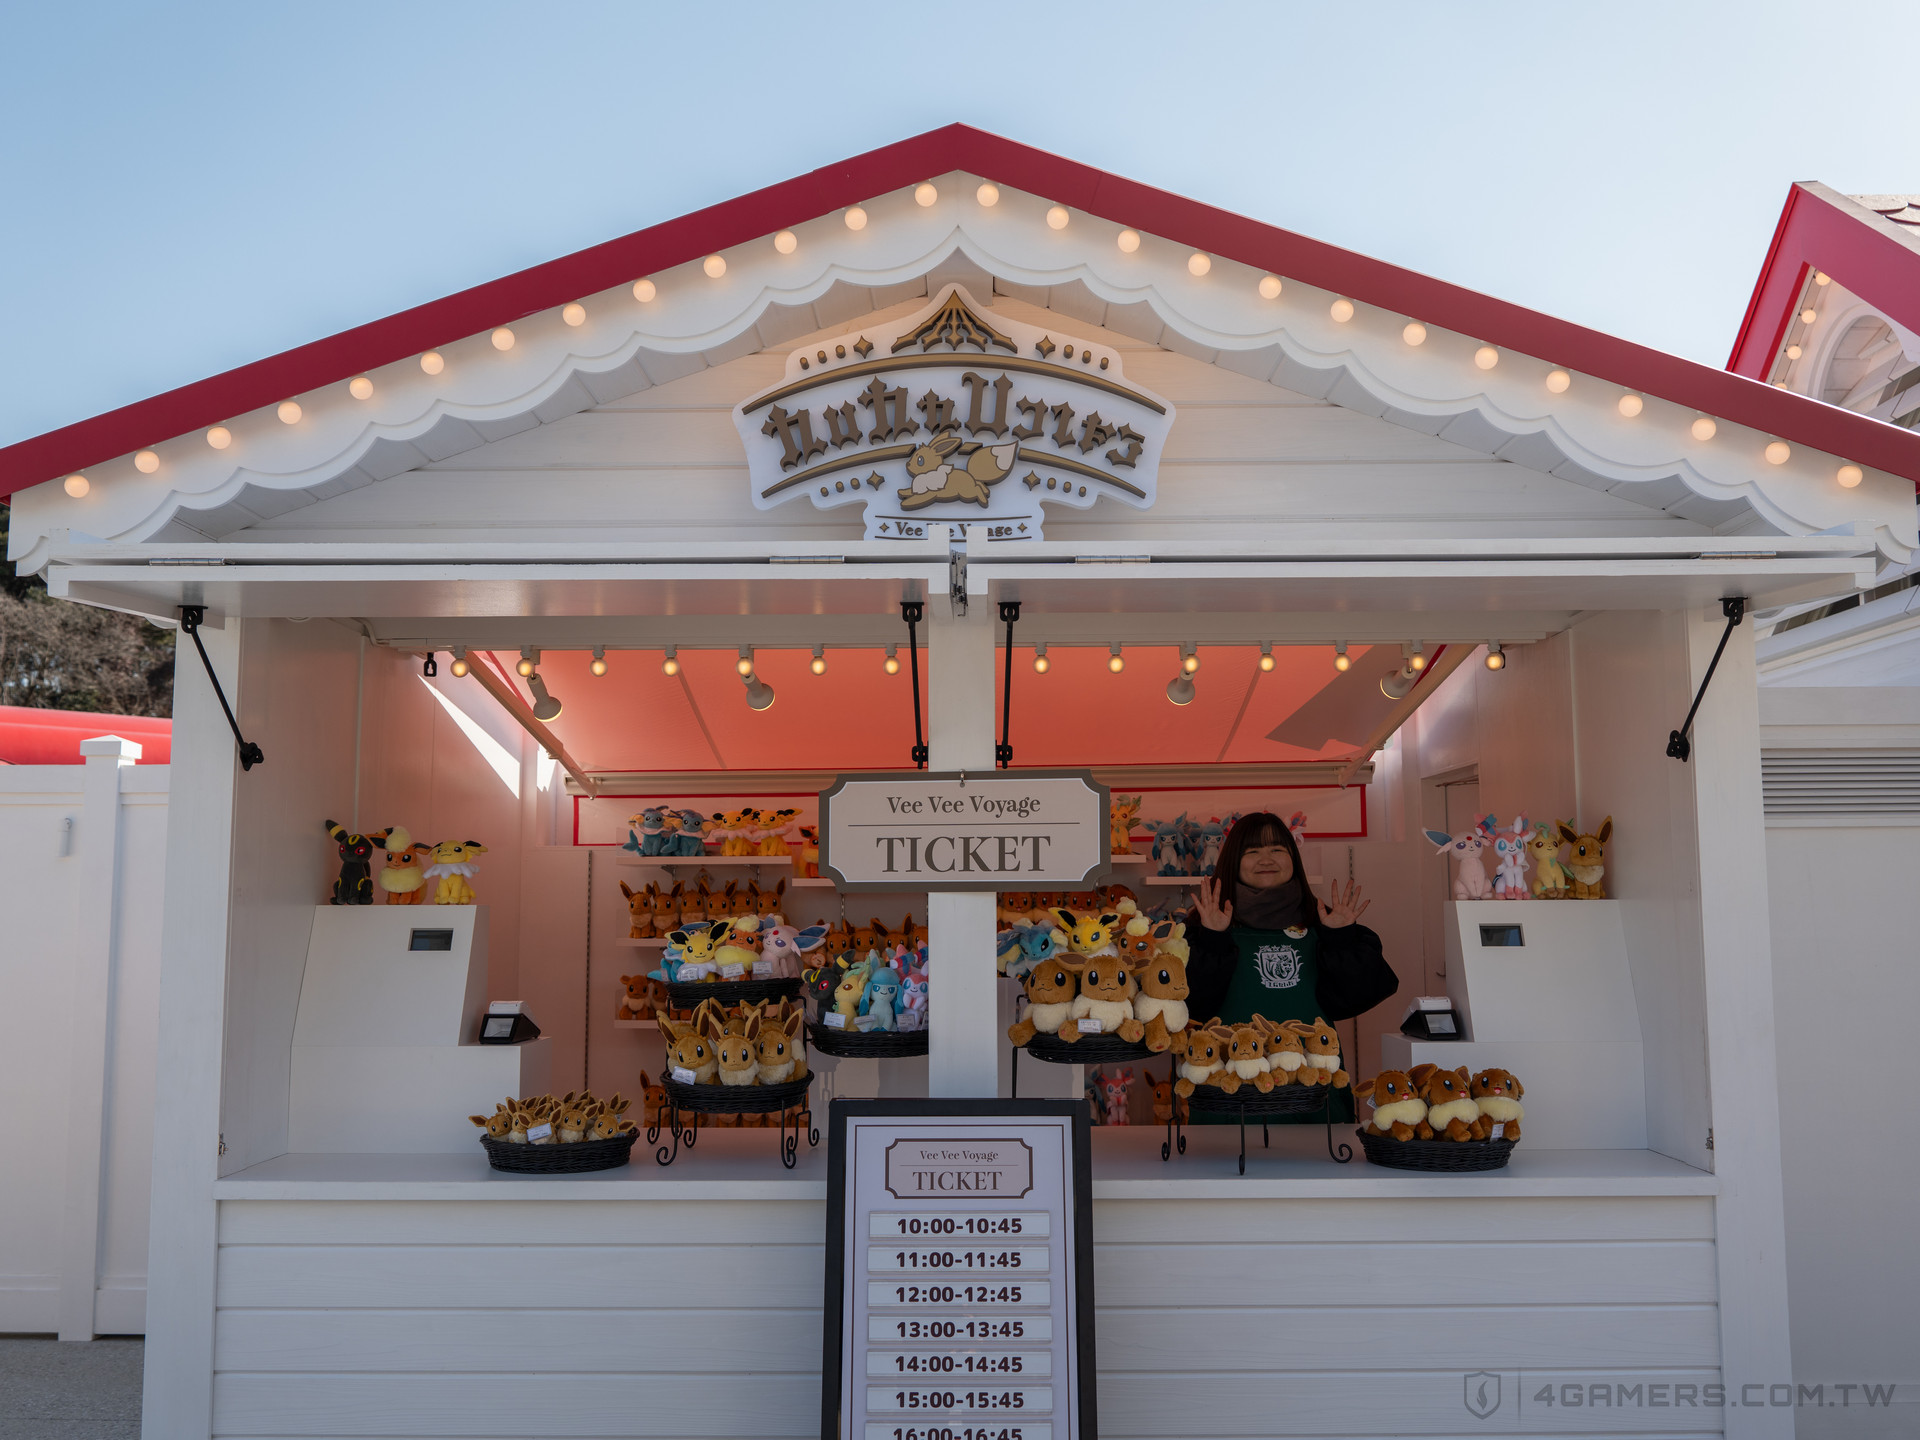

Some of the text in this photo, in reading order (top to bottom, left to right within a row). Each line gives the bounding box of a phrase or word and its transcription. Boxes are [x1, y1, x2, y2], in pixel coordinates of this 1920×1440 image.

[895, 521, 923, 536] Vee
[958, 523, 1013, 537] Vage
[886, 795, 1041, 818] Vee Vee Voyage
[876, 836, 1051, 873] TICKET
[919, 1150, 999, 1162] Vee Vee Voyage
[912, 1171, 1003, 1191] TICKET
[897, 1217, 1023, 1234] 10:00-10:45
[896, 1251, 1022, 1268] 11:00-11:45
[895, 1286, 1022, 1303] 12:00-12:45
[896, 1321, 1024, 1338] 13:00-13:45
[895, 1355, 1023, 1373] 14:00-14:45
[895, 1391, 1024, 1408] 15:00-15:45
